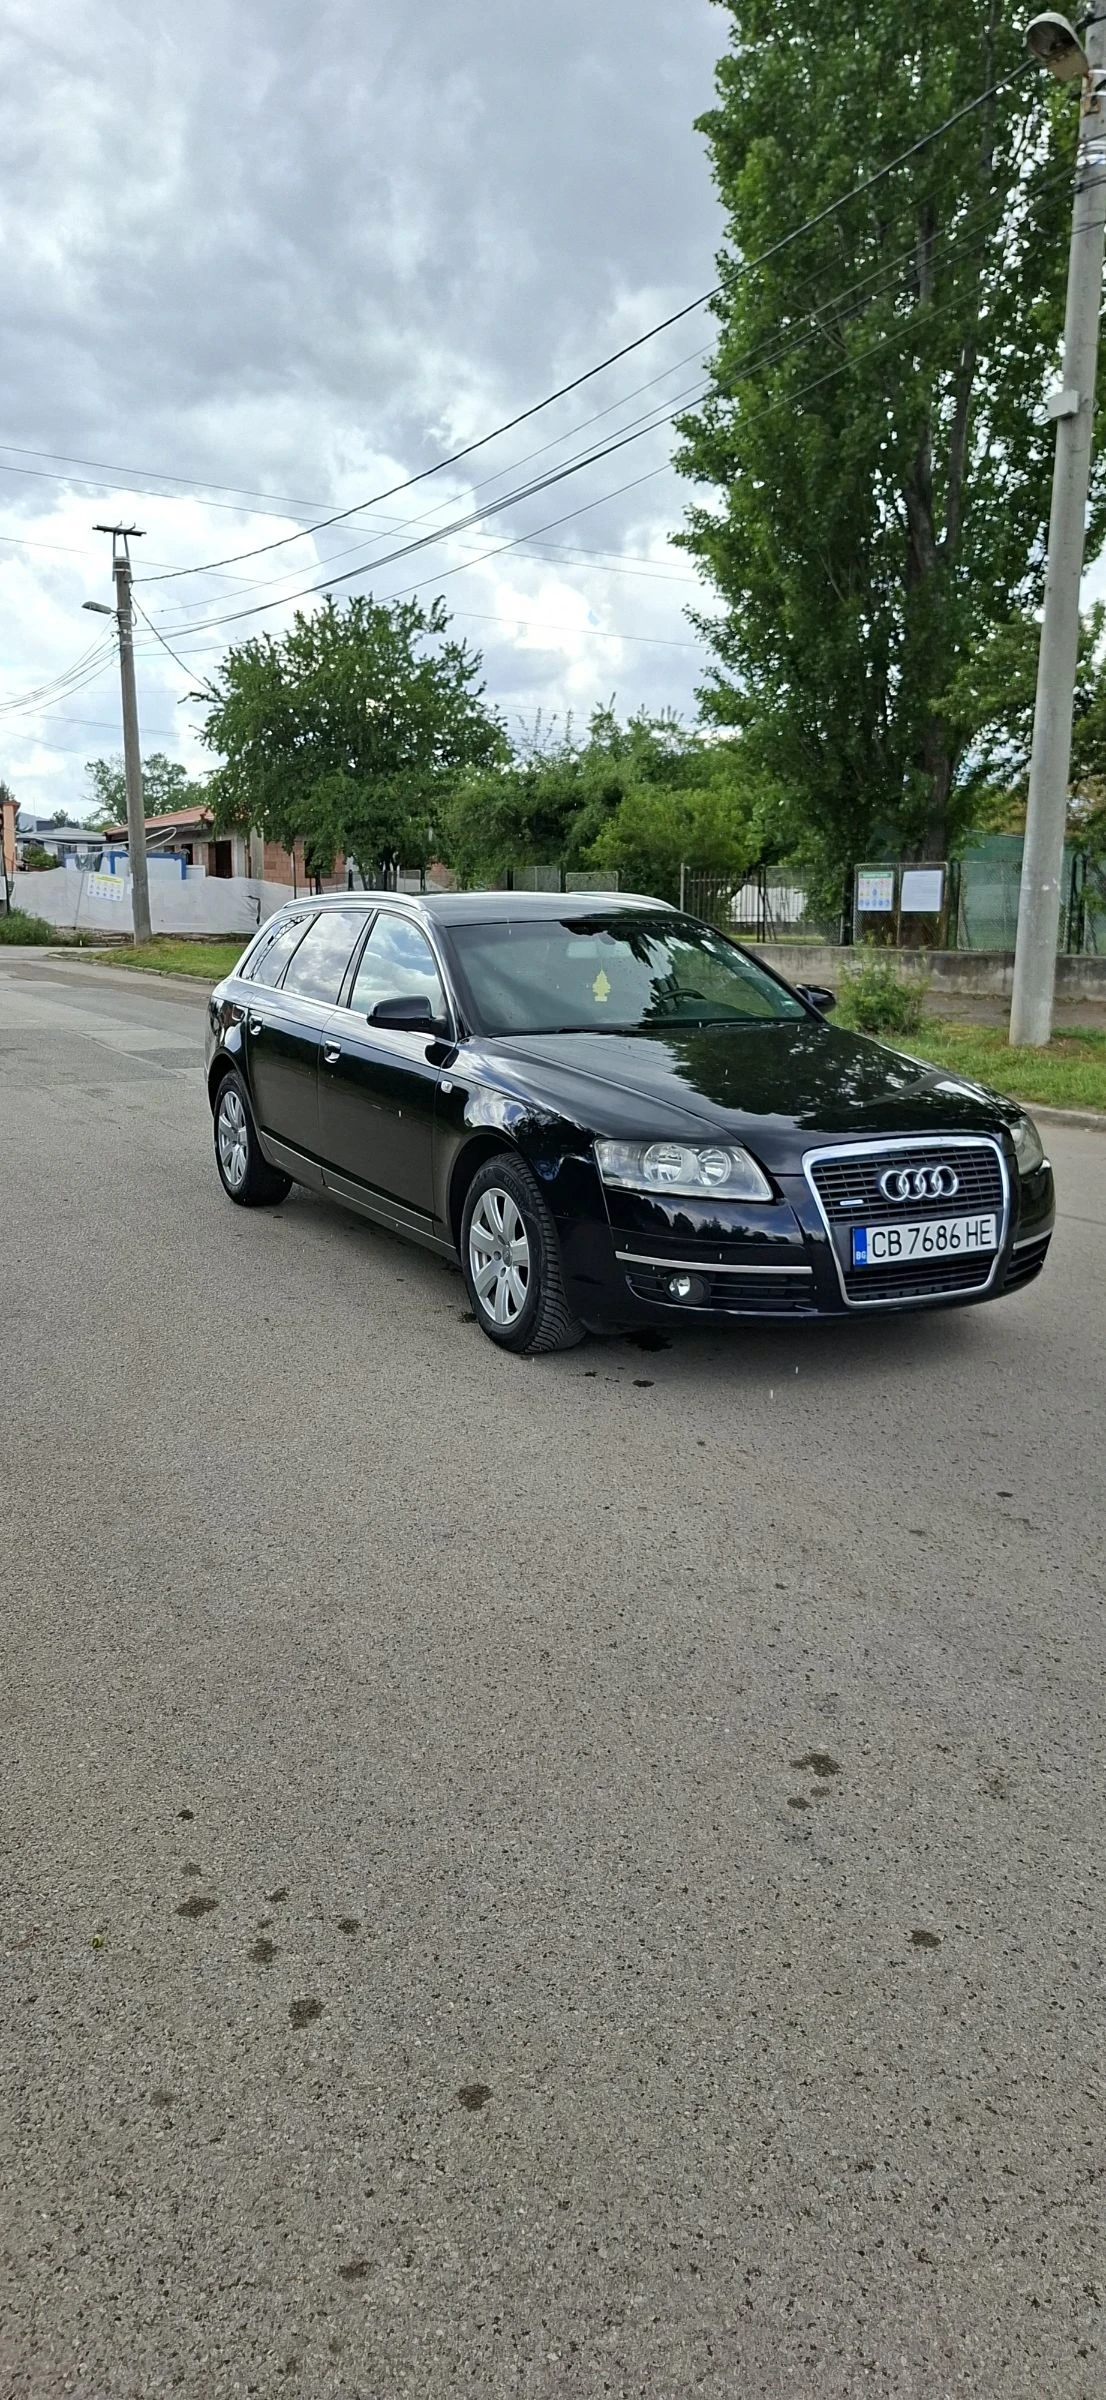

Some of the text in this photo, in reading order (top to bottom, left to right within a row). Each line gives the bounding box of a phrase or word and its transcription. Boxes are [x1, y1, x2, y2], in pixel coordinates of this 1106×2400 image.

[872, 1219, 992, 1258] CB 7686 HE
[855, 1250, 867, 1260] BG
